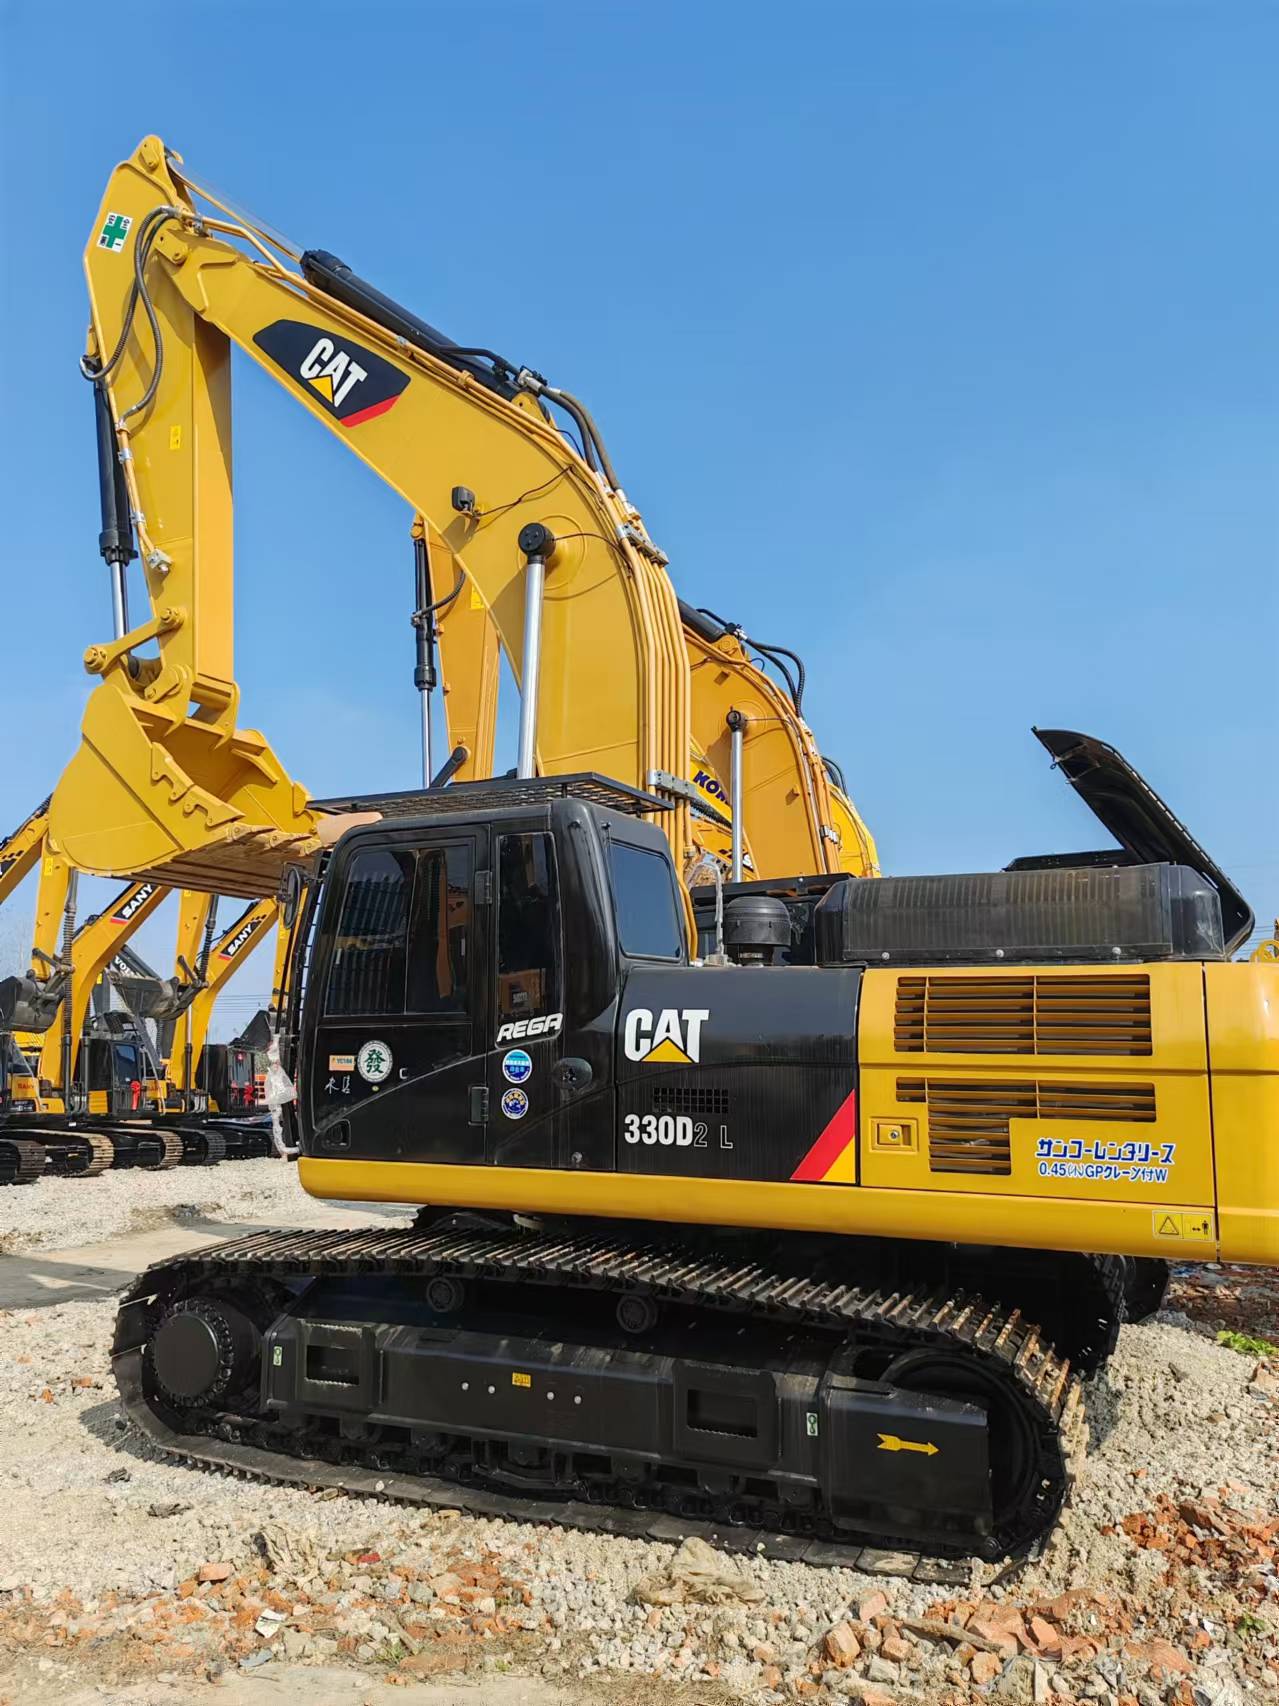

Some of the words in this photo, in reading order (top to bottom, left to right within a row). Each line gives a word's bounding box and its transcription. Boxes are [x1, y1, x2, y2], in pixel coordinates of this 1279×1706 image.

[300, 338, 368, 407] CAT
[121, 884, 153, 919] SANY
[228, 923, 253, 955] SANY
[496, 1012, 563, 1042] REGA
[624, 1008, 710, 1063] CAT
[720, 1125, 733, 1149] L
[1036, 1139, 1175, 1163] サンコーレンタリース
